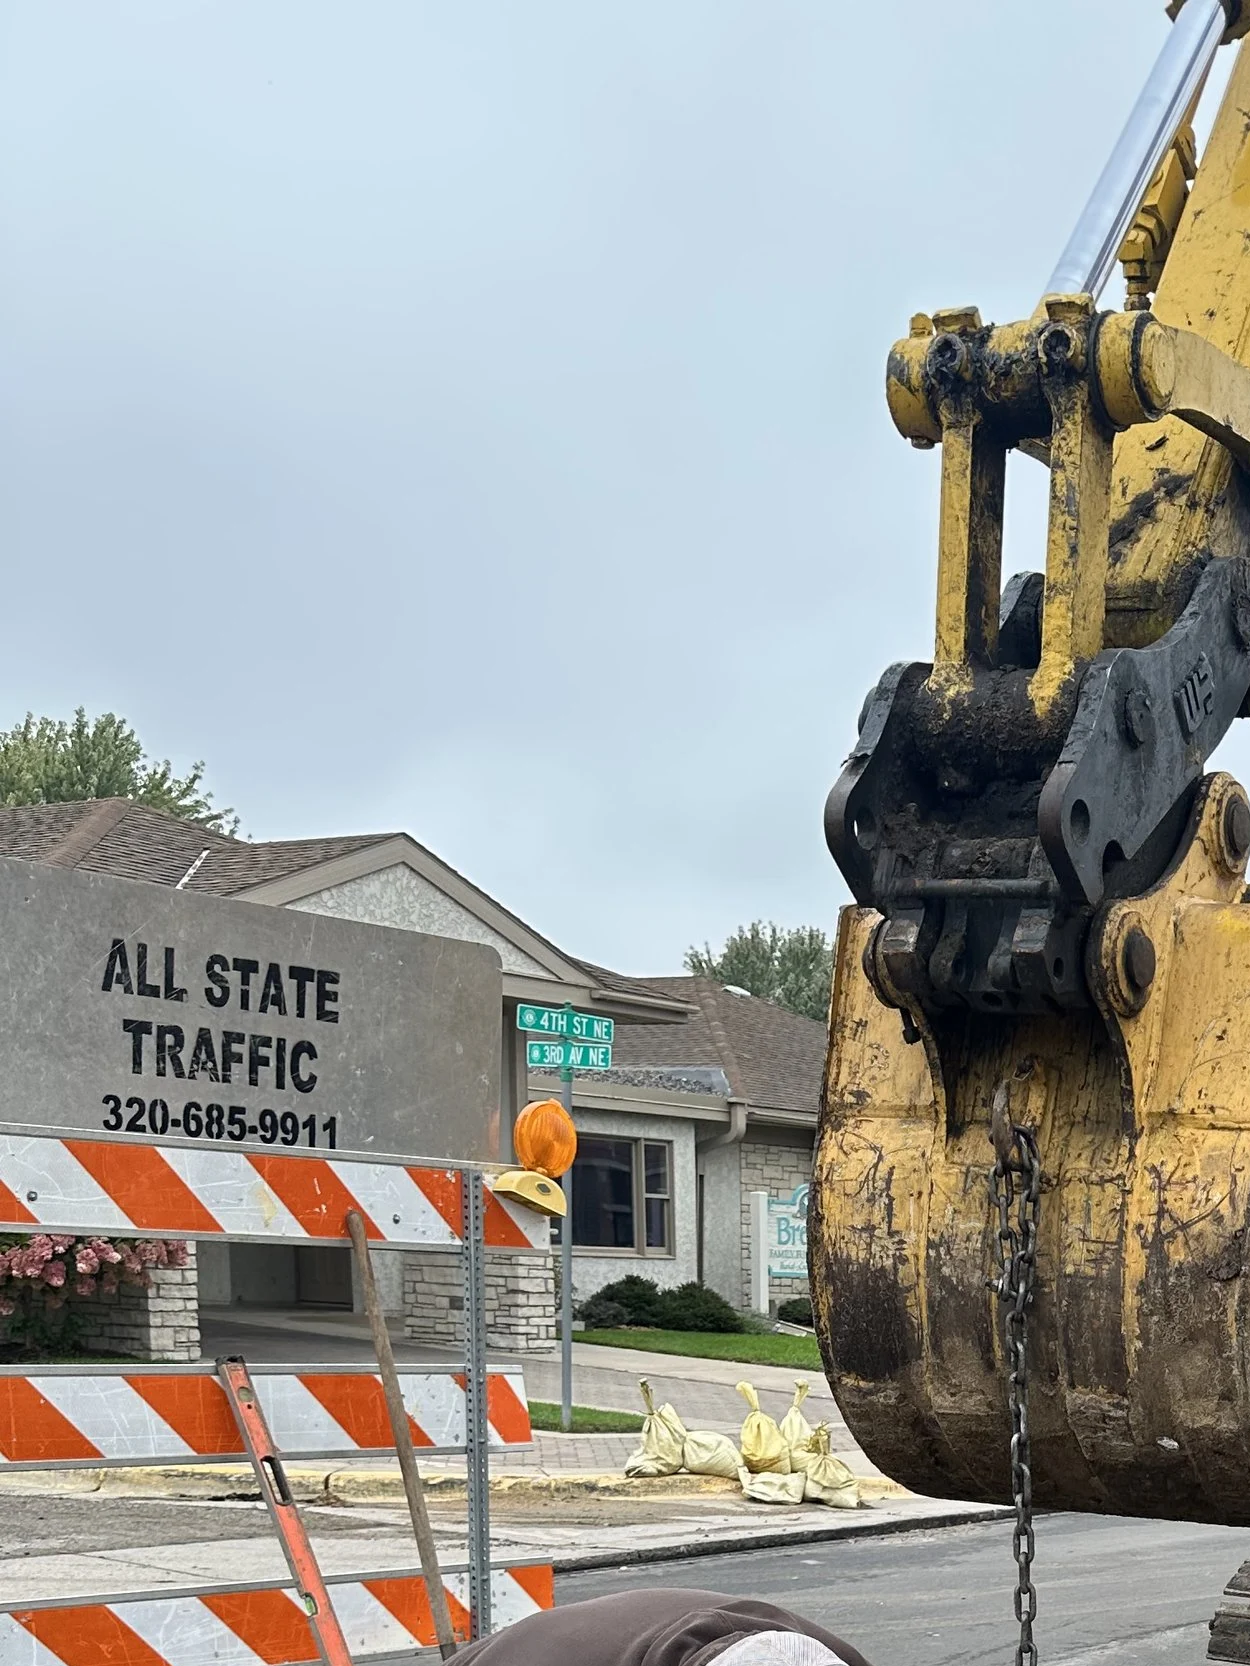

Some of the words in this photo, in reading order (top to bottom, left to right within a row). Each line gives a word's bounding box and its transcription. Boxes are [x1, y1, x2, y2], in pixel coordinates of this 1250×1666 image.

[101, 938, 187, 1002] ALL
[204, 954, 340, 1023] STATE
[540, 1012, 567, 1032] 4TH
[572, 1016, 588, 1036] ST
[593, 1020, 610, 1040] NE
[122, 1018, 319, 1094] TRAFFIC
[543, 1045, 564, 1063] 3RD
[568, 1046, 583, 1065] AV
[589, 1048, 606, 1066] NE
[101, 1094, 337, 1150] 320-685-9911
